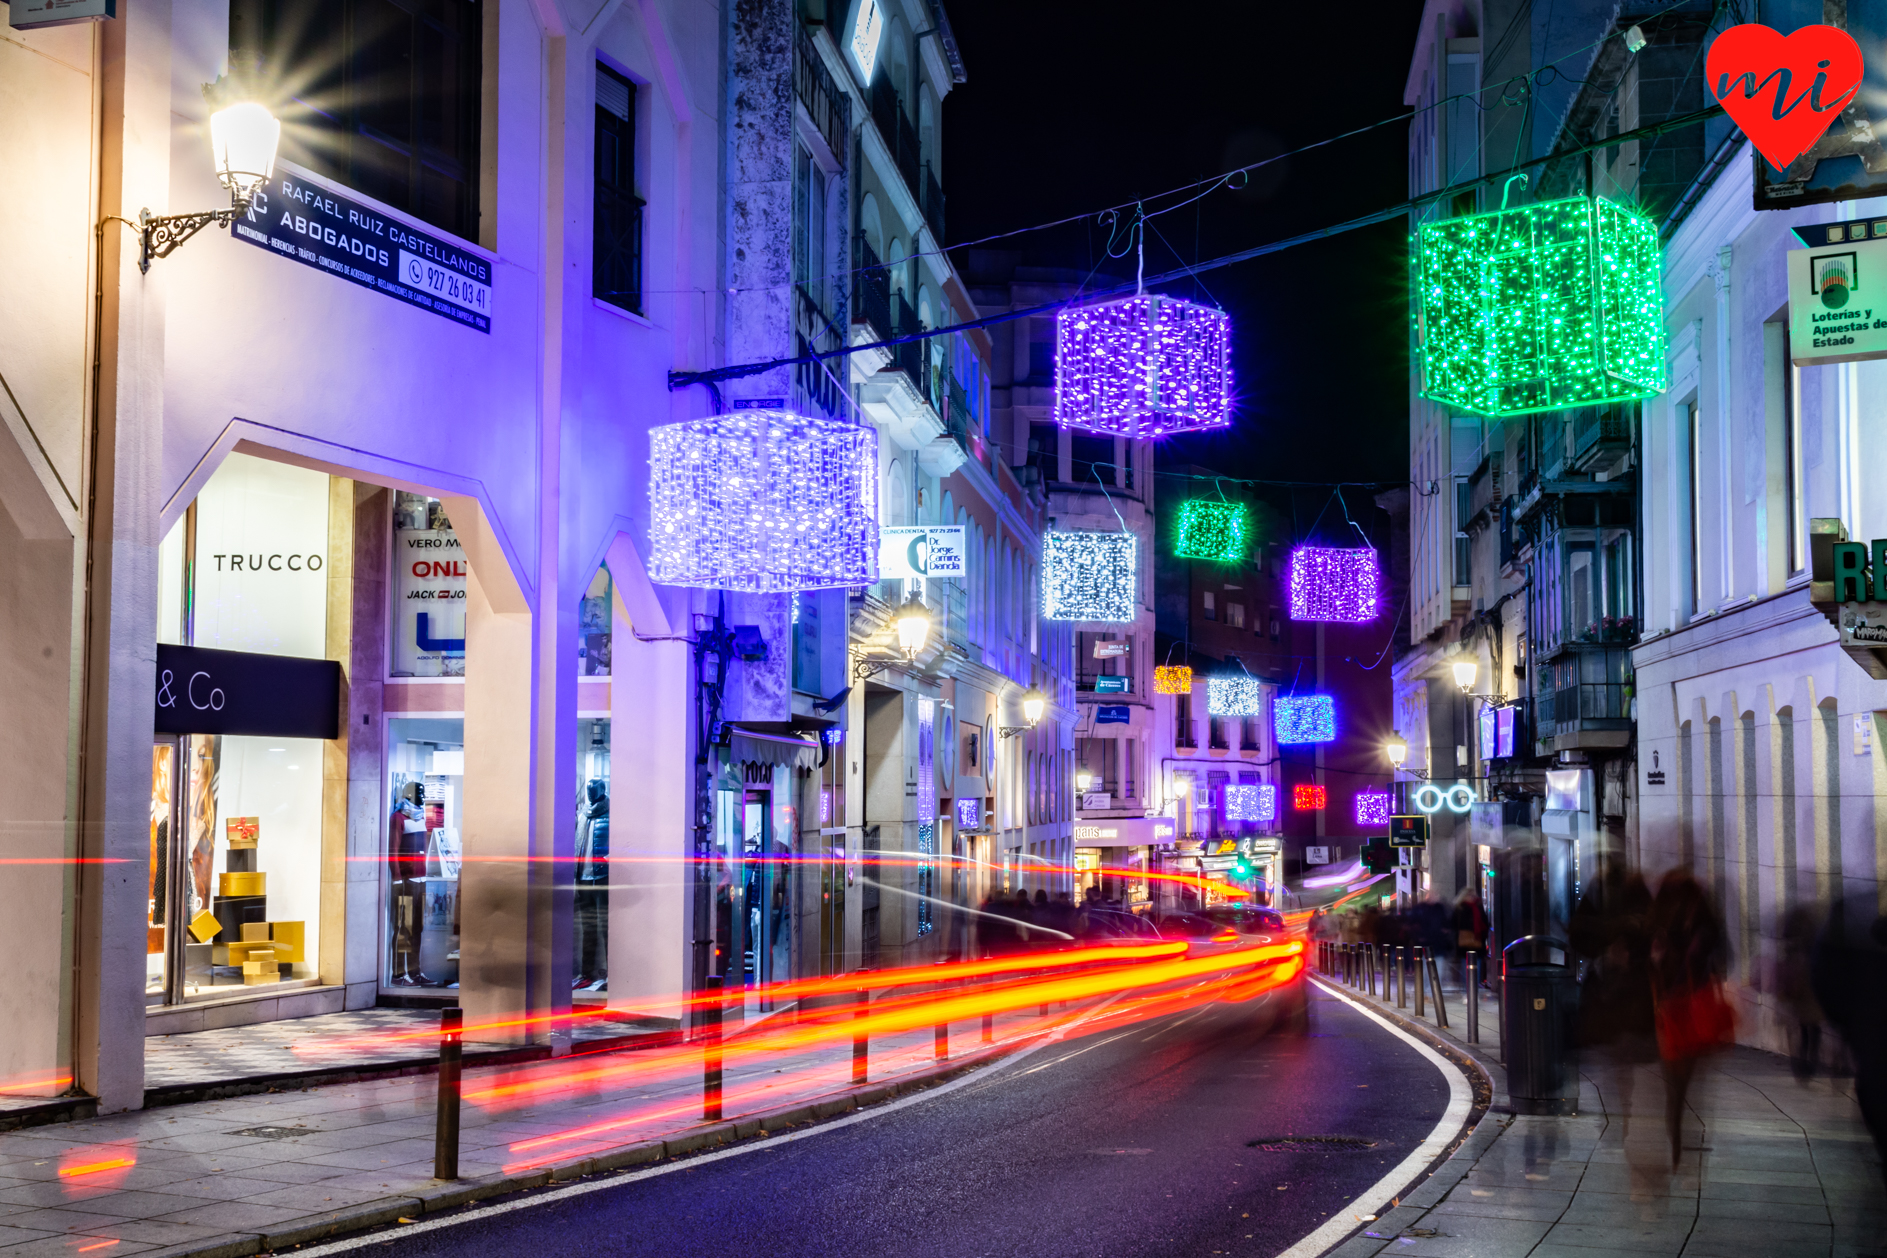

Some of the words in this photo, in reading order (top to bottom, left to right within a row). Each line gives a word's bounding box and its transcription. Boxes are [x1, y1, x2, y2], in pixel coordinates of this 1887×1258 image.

[280, 211, 388, 267] ABOGADOS
[282, 181, 343, 219] RAFAEL
[349, 209, 384, 236] RUIZ
[390, 227, 486, 280] CASTELLANOS
[237, 224, 268, 244] MATRIMONIAL
[271, 237, 295, 255] HERENCIAS
[298, 247, 316, 262] TRÁFICO
[318, 256, 343, 272] CONCURSOS
[344, 264, 350, 275] DE
[350, 267, 375, 284] ACREEDORES
[378, 278, 407, 297] RECLAMACIONES
[428, 267, 445, 291] 927
[448, 276, 459, 298] 26
[462, 282, 473, 304] 03
[476, 288, 485, 309] 41
[1812, 309, 1860, 322] Loterías
[1865, 309, 1872, 319] y
[1813, 322, 1869, 336] Apuestas
[1873, 319, 1887, 329] de
[1813, 335, 1854, 348] Estado
[408, 539, 442, 548] VERO
[446, 539, 461, 547] M
[930, 546, 954, 555] Jorge
[214, 554, 322, 571] TRUCCO
[412, 561, 467, 578] ONL
[407, 590, 436, 599] JACK
[450, 590, 466, 599] JO
[157, 669, 176, 708] &
[189, 671, 225, 710] Co
[1075, 827, 1100, 841] pans
